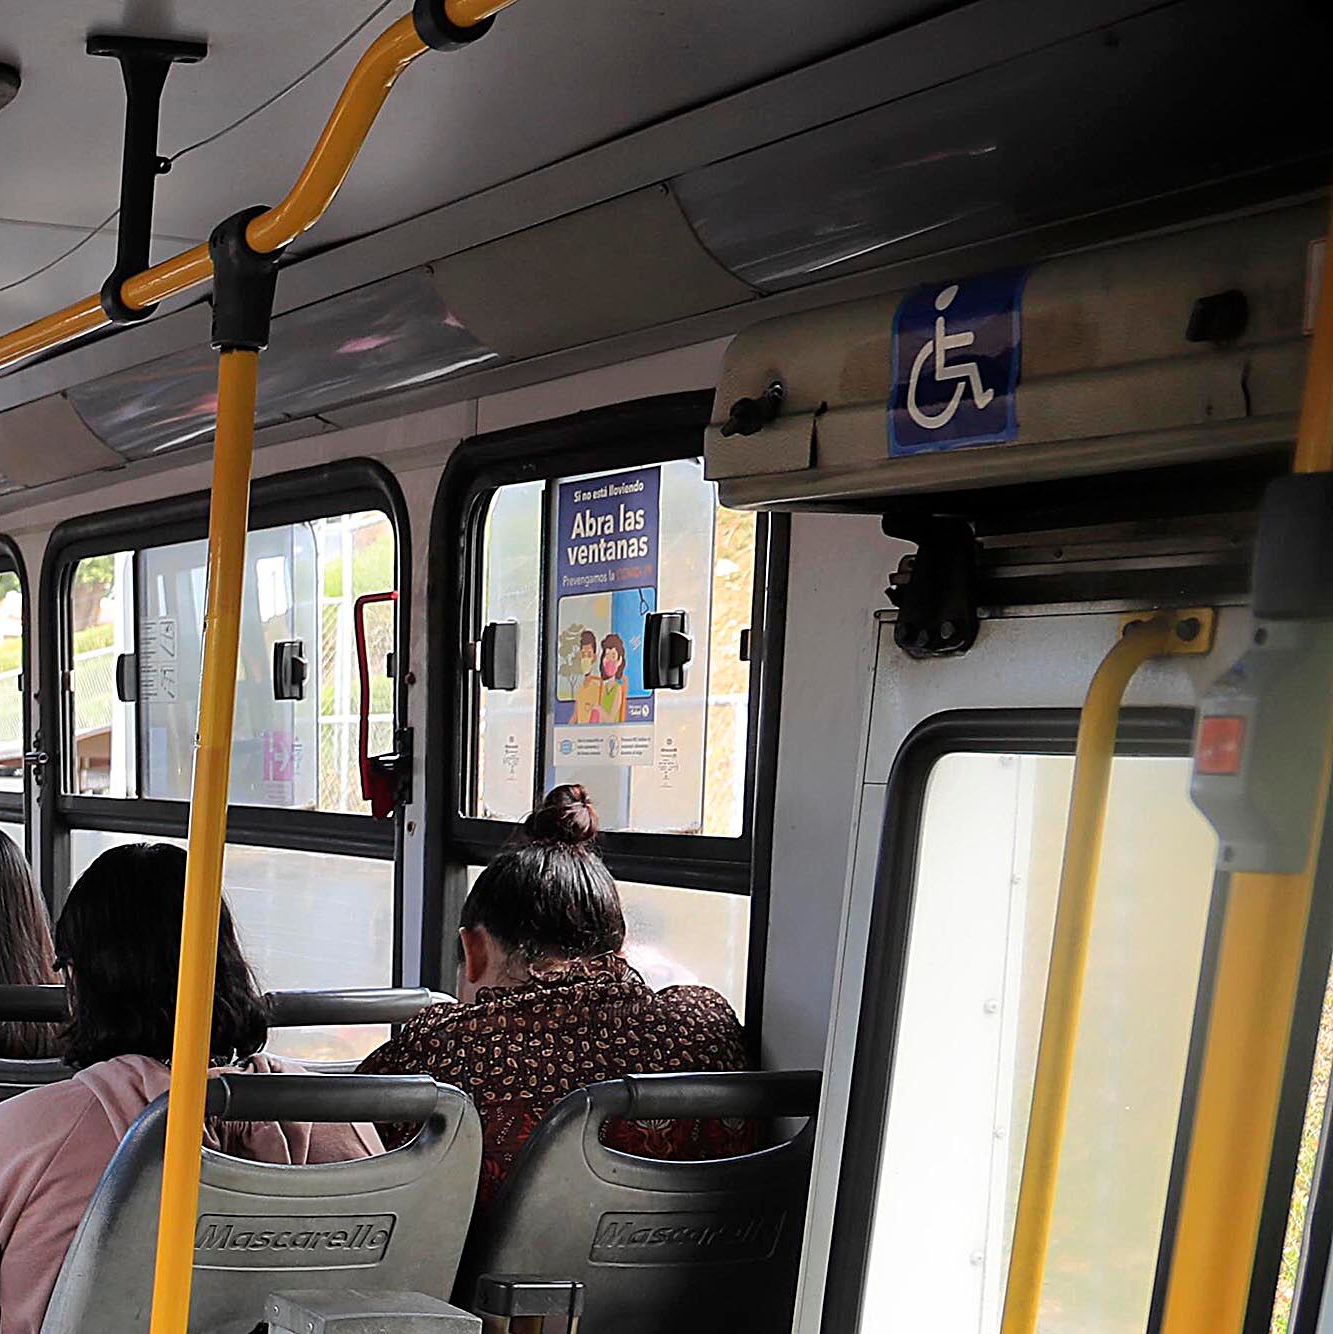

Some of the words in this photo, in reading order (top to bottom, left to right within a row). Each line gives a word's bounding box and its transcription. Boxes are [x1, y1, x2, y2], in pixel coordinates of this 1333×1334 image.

[582, 491, 591, 501] no
[593, 486, 607, 499] está
[609, 480, 644, 496] lloviendo
[571, 509, 613, 539] Abra
[619, 503, 645, 532] las
[567, 536, 648, 566] ventanas
[563, 575, 607, 587] Prevengamos
[608, 569, 615, 581] la
[195, 1214, 389, 1251] Mascarello
